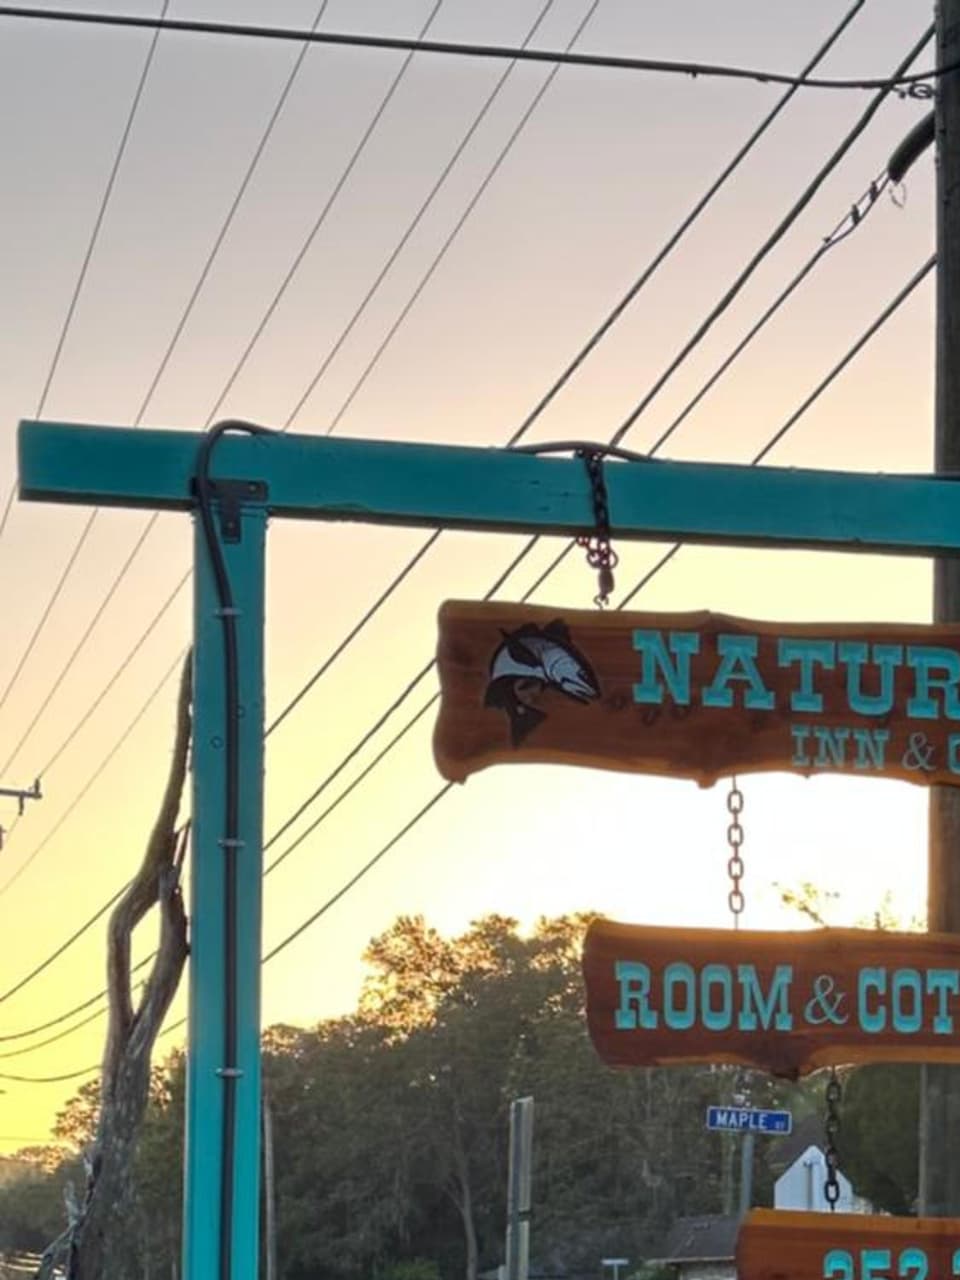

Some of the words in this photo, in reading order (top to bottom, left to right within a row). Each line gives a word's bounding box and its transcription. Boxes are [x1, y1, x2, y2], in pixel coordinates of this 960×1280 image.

[791, 725, 889, 769] INN
[902, 732, 937, 771] &
[614, 960, 794, 1032] ROOM
[804, 974, 850, 1025] &
[716, 1111, 769, 1129] MAPLE
